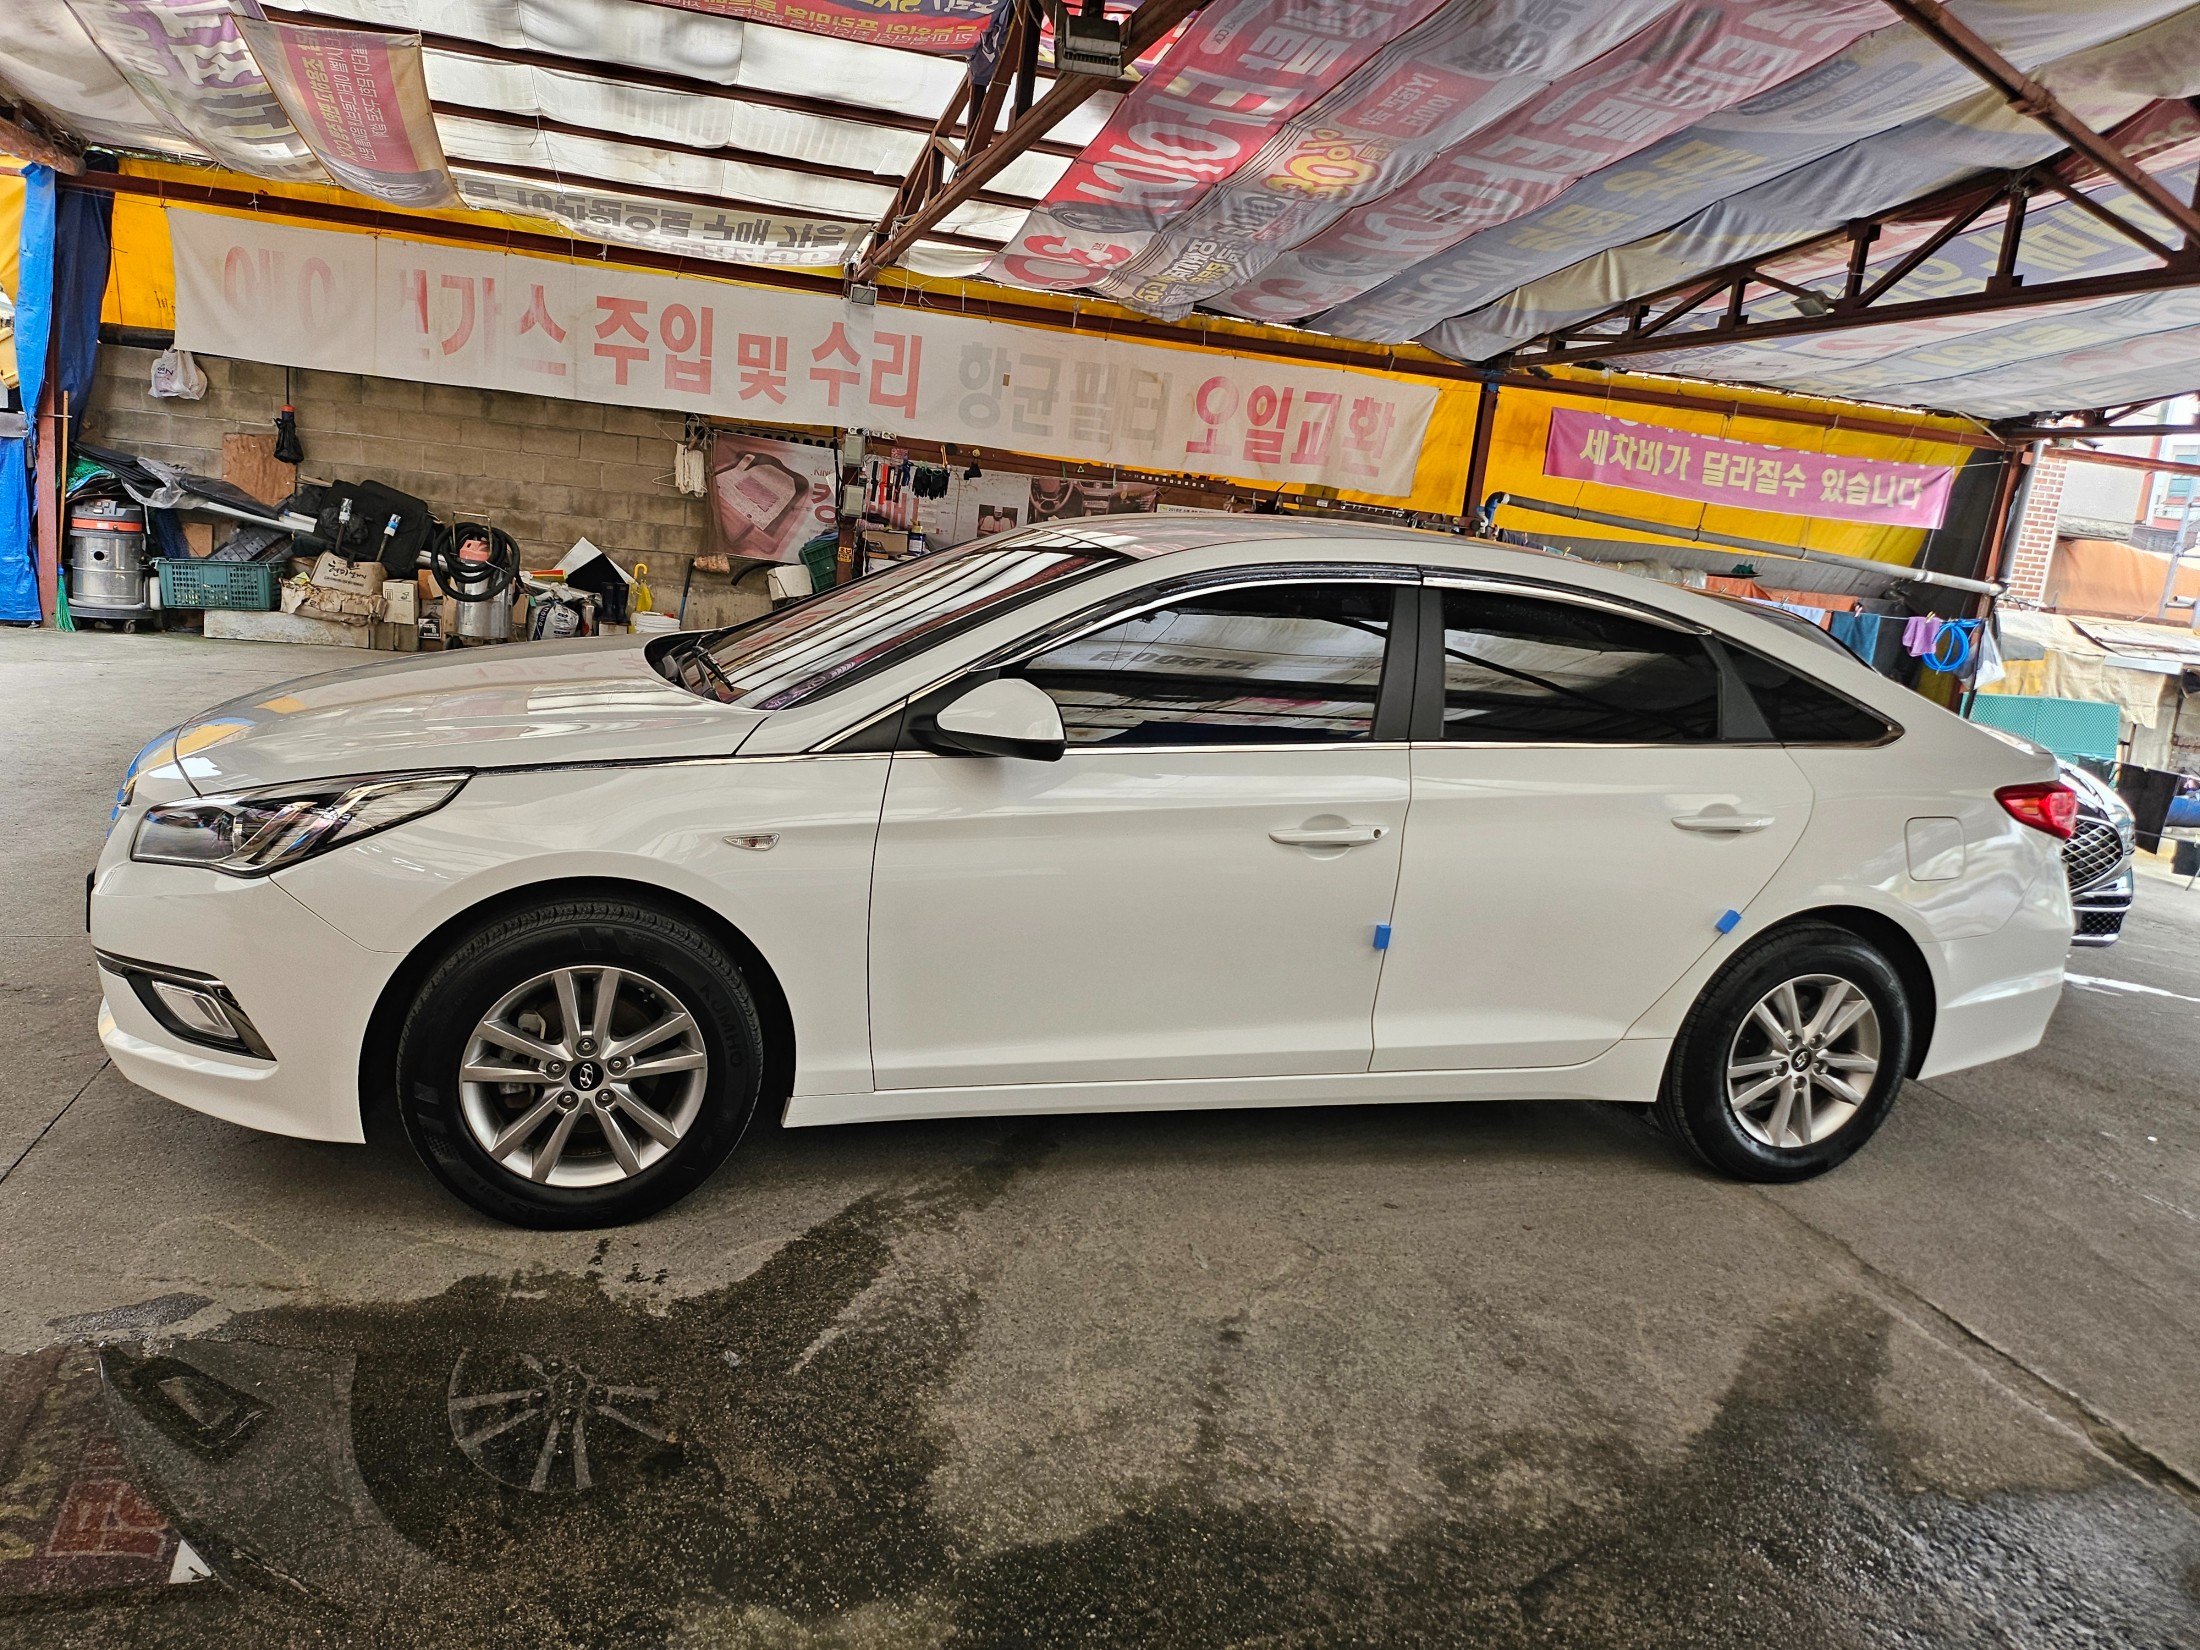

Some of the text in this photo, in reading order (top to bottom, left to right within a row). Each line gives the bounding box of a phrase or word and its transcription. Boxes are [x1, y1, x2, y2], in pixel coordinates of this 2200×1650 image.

[593, 295, 715, 396] 주입
[737, 332, 789, 405] 및
[809, 321, 924, 420] 수리
[1185, 375, 1397, 479] 오일교환
[1578, 428, 1693, 482] 세차비가
[1701, 450, 1809, 498] 달라질수
[1818, 466, 1924, 511] 있습니다
